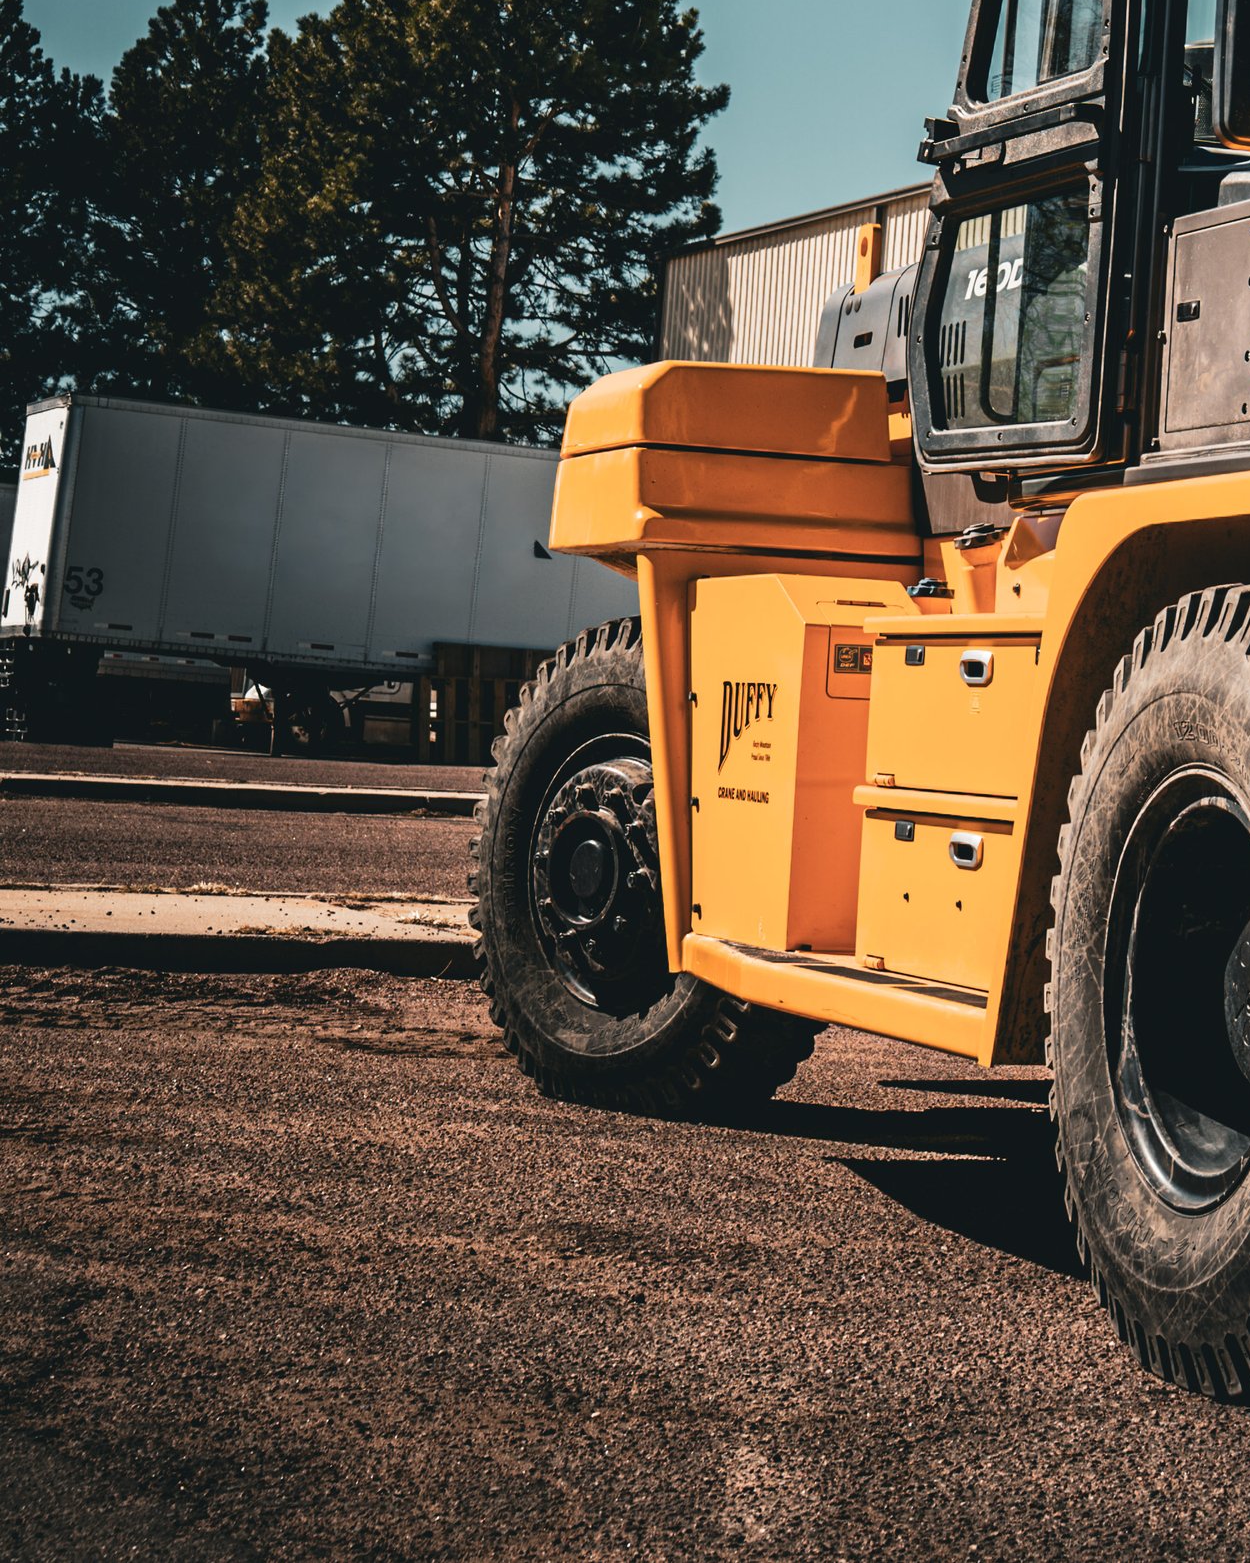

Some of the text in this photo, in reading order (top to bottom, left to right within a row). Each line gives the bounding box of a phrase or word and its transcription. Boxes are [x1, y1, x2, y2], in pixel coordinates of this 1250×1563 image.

[965, 258, 1024, 300] 160D
[64, 566, 104, 596] 53
[718, 681, 778, 775] DUFFY
[718, 786, 769, 804] CRANE AND HAULING
